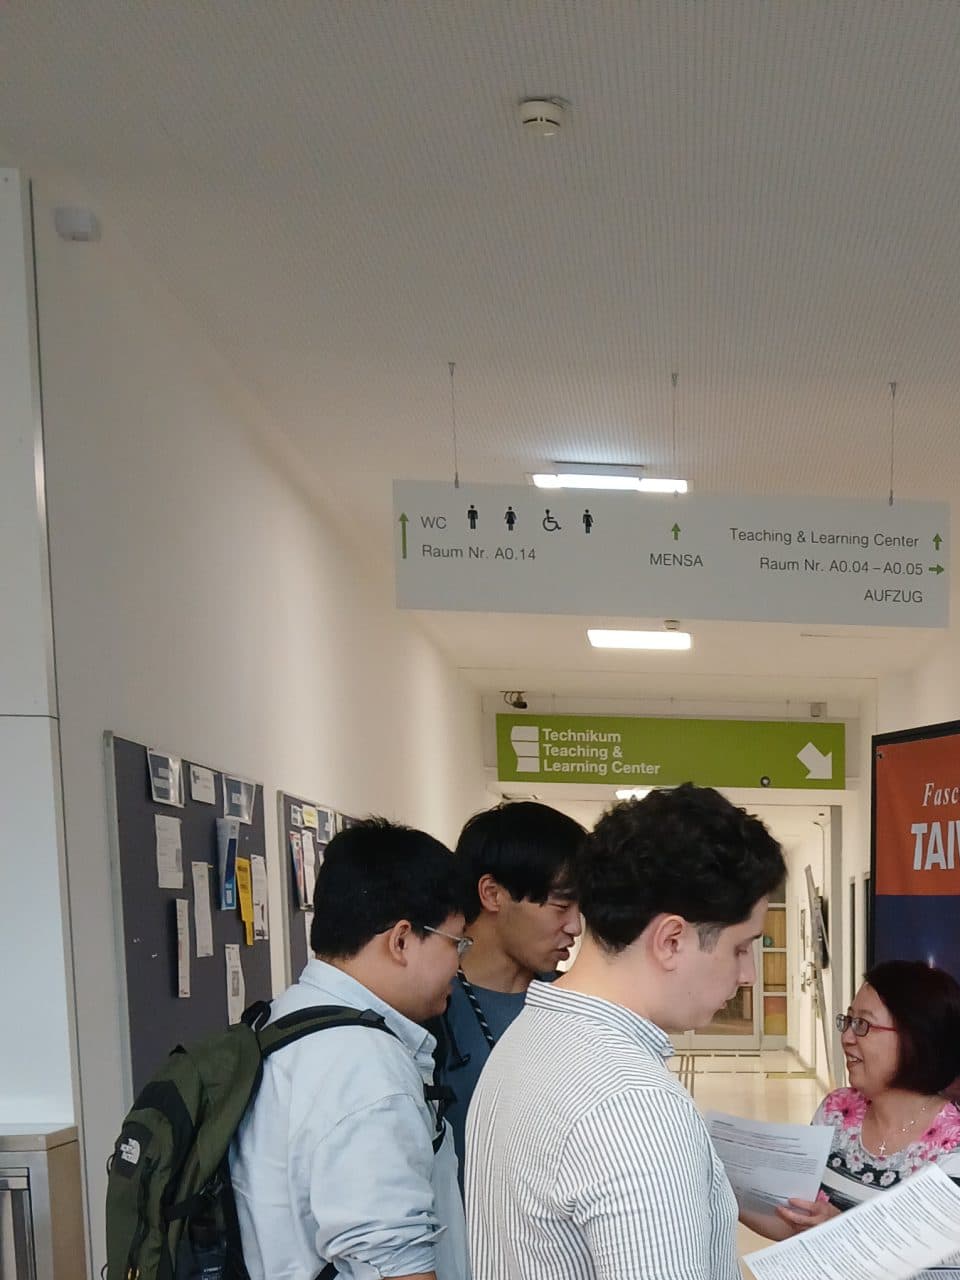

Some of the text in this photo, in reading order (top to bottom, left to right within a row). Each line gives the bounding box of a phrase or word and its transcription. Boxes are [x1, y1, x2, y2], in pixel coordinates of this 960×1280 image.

[420, 516, 447, 529] WC
[729, 527, 919, 549] Teaching & Learning Center
[422, 544, 536, 560] Raum Nr. A0.14
[649, 553, 703, 568] MENSA
[760, 557, 799, 571] Raum
[804, 559, 825, 572] Nr.
[829, 560, 869, 573] A0.04
[883, 562, 923, 575] A0.05
[864, 589, 923, 603] AUFZUG
[542, 728, 622, 742] Technikum
[543, 744, 623, 760] Teaching &
[543, 759, 661, 776] Learning Center
